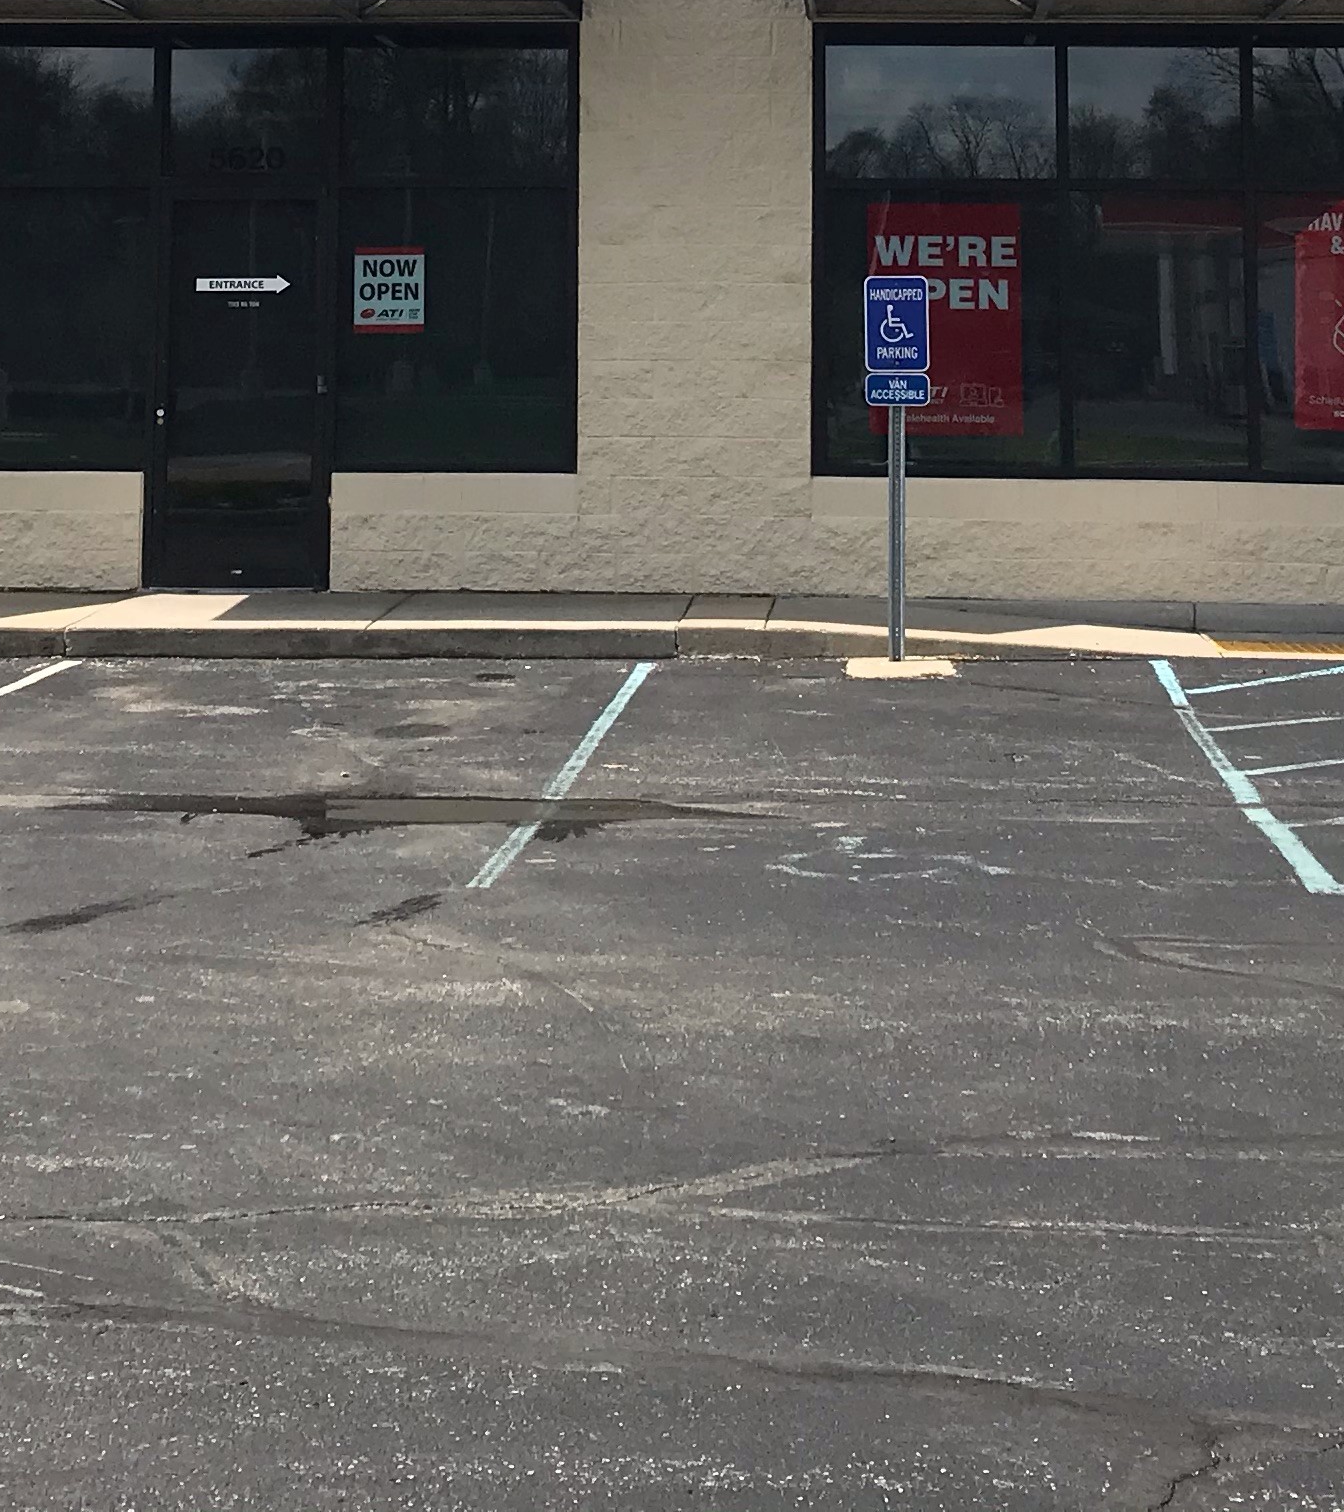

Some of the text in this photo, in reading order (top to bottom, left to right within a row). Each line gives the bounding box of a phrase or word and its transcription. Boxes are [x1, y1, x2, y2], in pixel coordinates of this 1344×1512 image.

[209, 146, 285, 170] 5620
[874, 235, 1018, 268] WE'RE
[362, 259, 418, 278] NOW
[209, 280, 265, 290] ENTRANCE
[359, 282, 419, 301] OPEN
[869, 288, 923, 301] HANDICAPPED
[927, 278, 1009, 311] PEN
[377, 309, 404, 318] ATI
[876, 346, 918, 359] PARKING
[888, 379, 908, 390] VAN
[870, 389, 925, 400] ACCESSIBLE
[905, 414, 950, 423] elehealth
